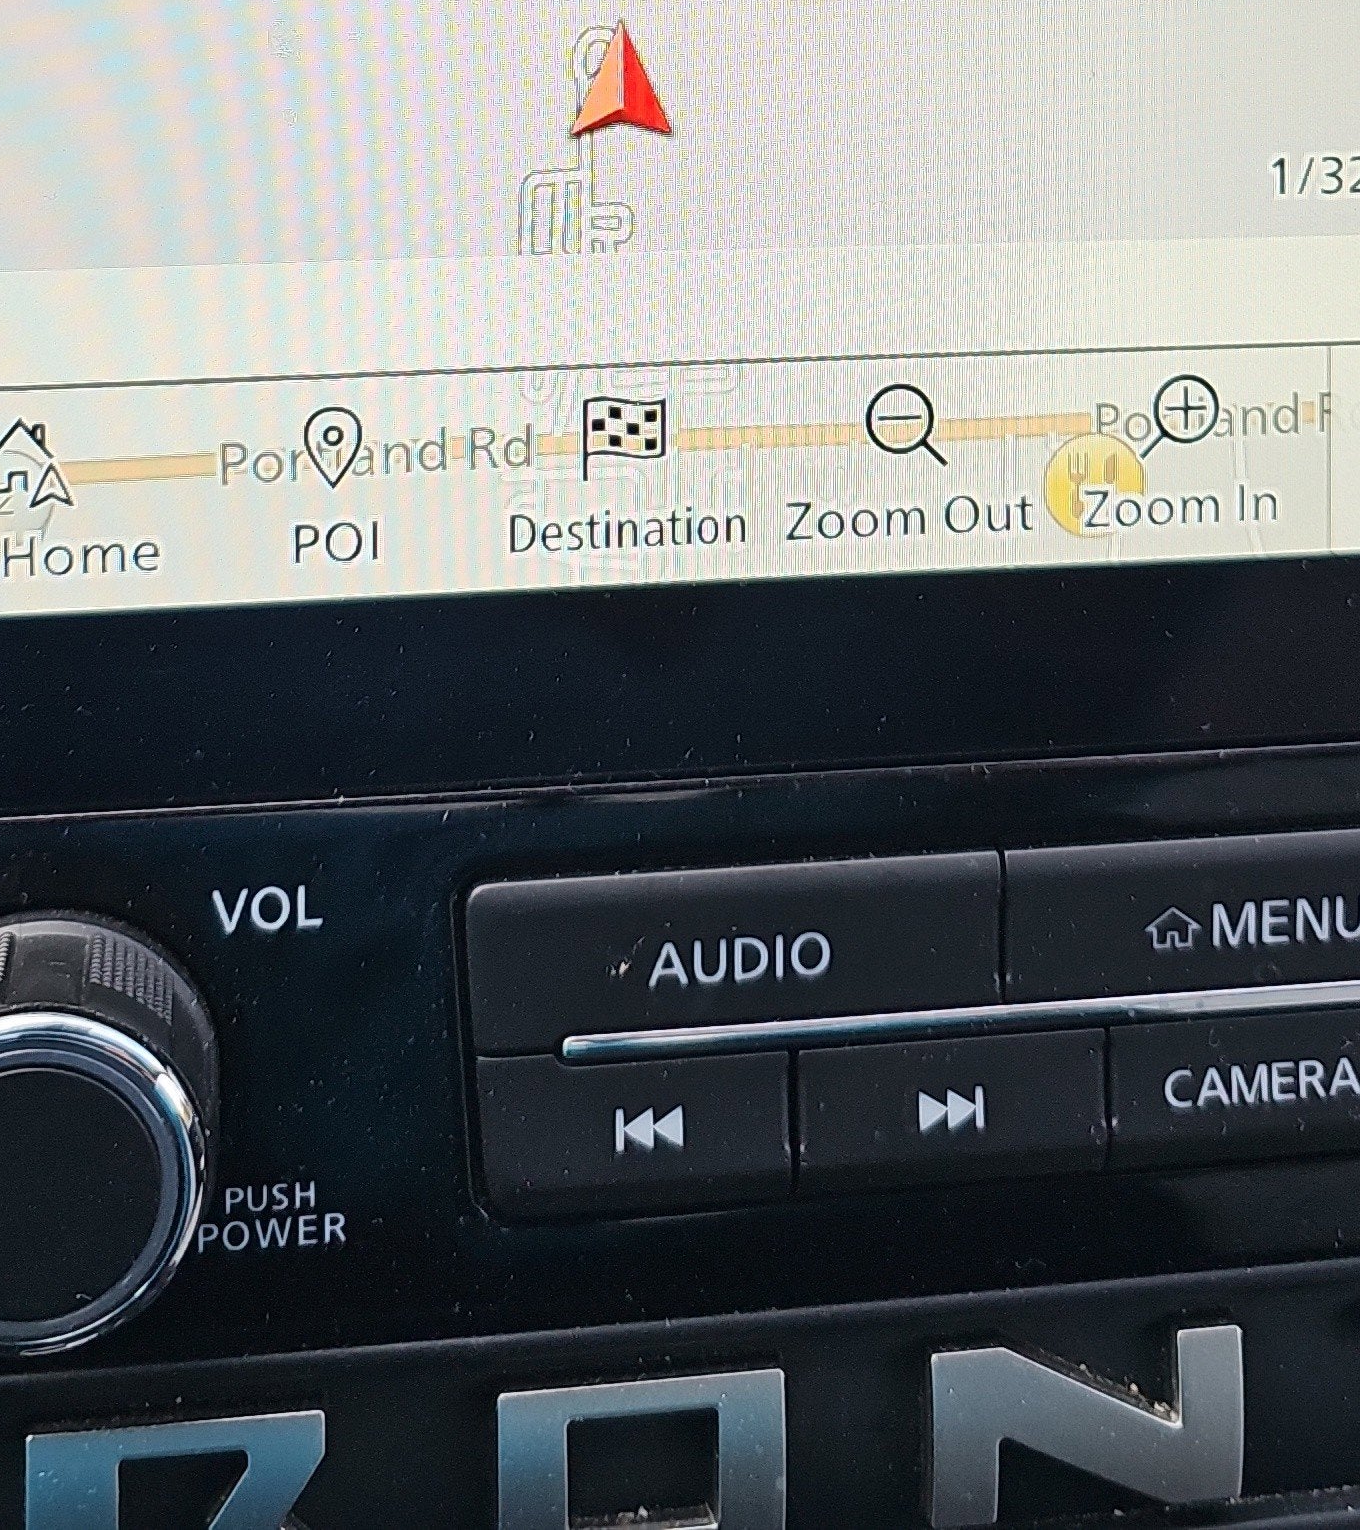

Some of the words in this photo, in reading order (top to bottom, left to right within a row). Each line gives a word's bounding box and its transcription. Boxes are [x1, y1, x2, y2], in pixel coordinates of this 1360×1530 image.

[470, 422, 533, 472] Rd
[510, 507, 746, 553] Destination
[785, 498, 926, 542] Zoom
[945, 492, 1034, 533] Out
[1084, 488, 1220, 530] Zoom
[1239, 484, 1278, 521] In
[3, 532, 161, 579] Home
[294, 522, 379, 563] POI
[212, 885, 324, 934] VOL
[648, 932, 831, 990] AUDIO
[225, 1181, 316, 1215] PUSH
[197, 1213, 346, 1254] POWER
